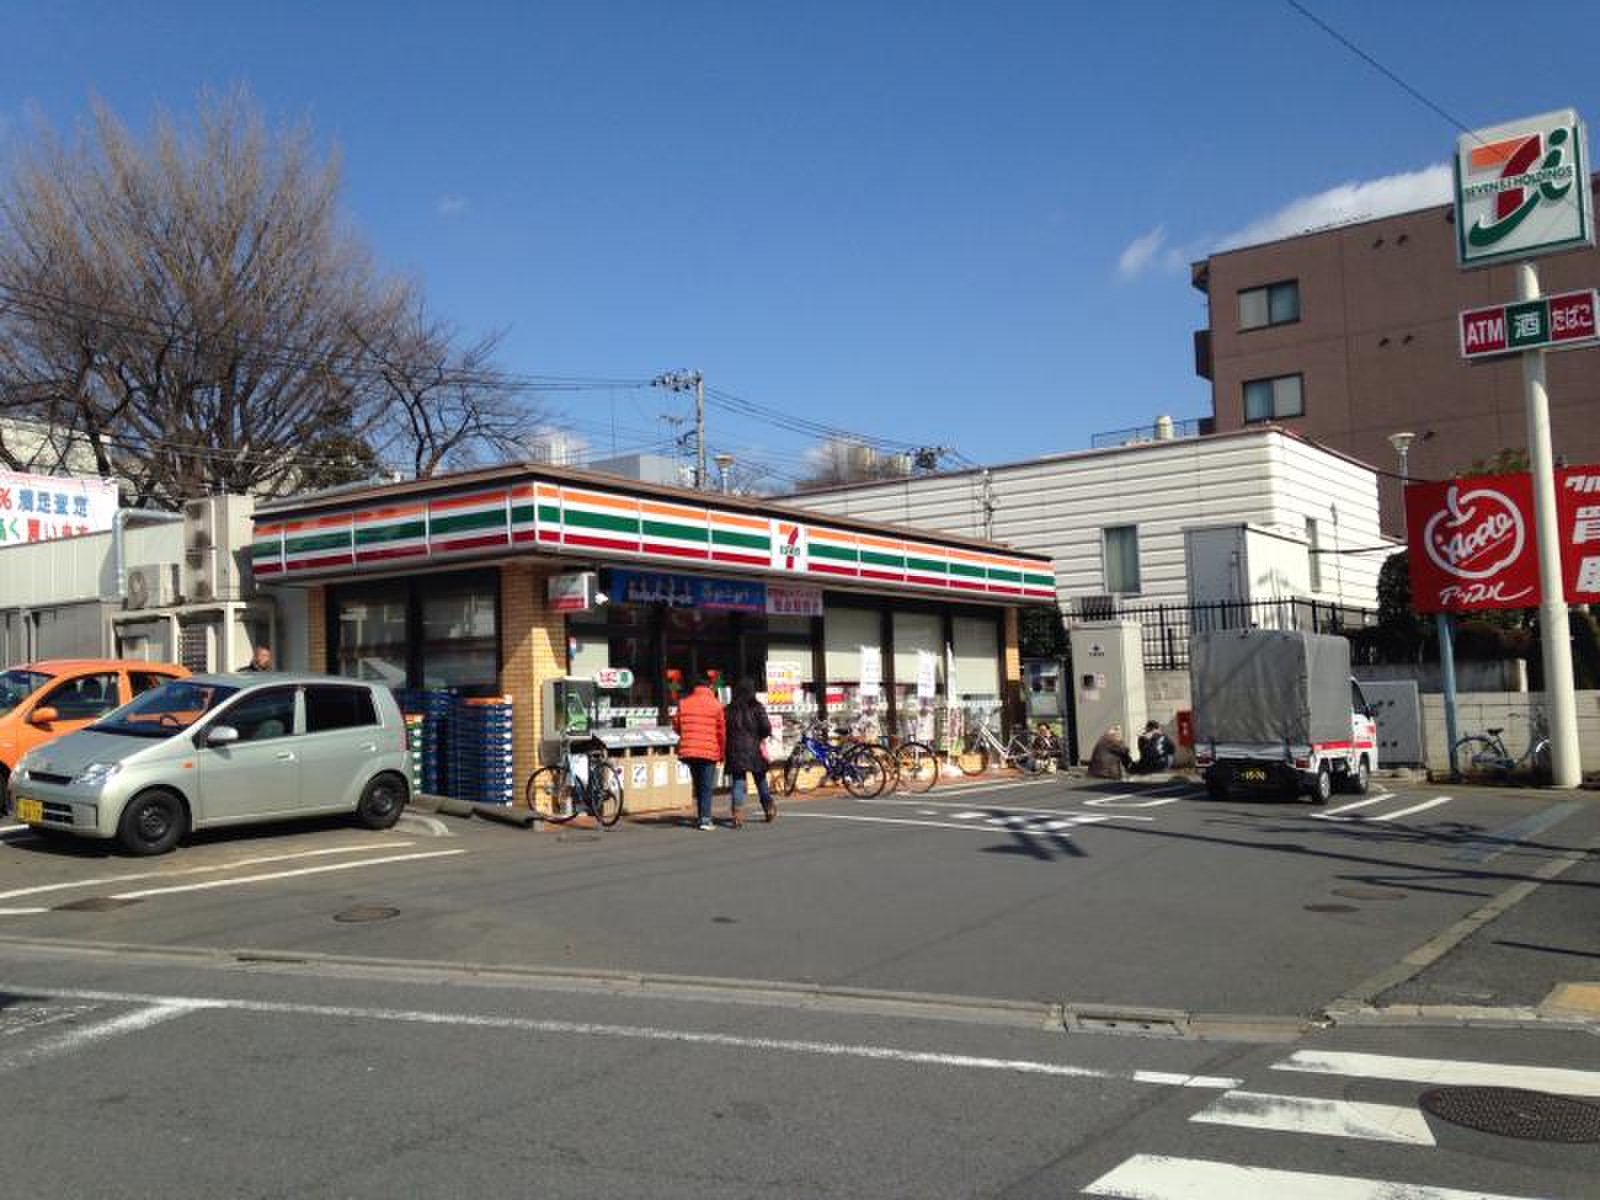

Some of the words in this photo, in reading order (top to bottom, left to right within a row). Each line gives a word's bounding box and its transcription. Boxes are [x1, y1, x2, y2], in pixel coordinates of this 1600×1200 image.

[1513, 164, 1574, 188] HOLDINGS
[1466, 318, 1504, 346] ATM
[1514, 312, 1539, 338] 酒
[1551, 303, 1592, 332] たばこ
